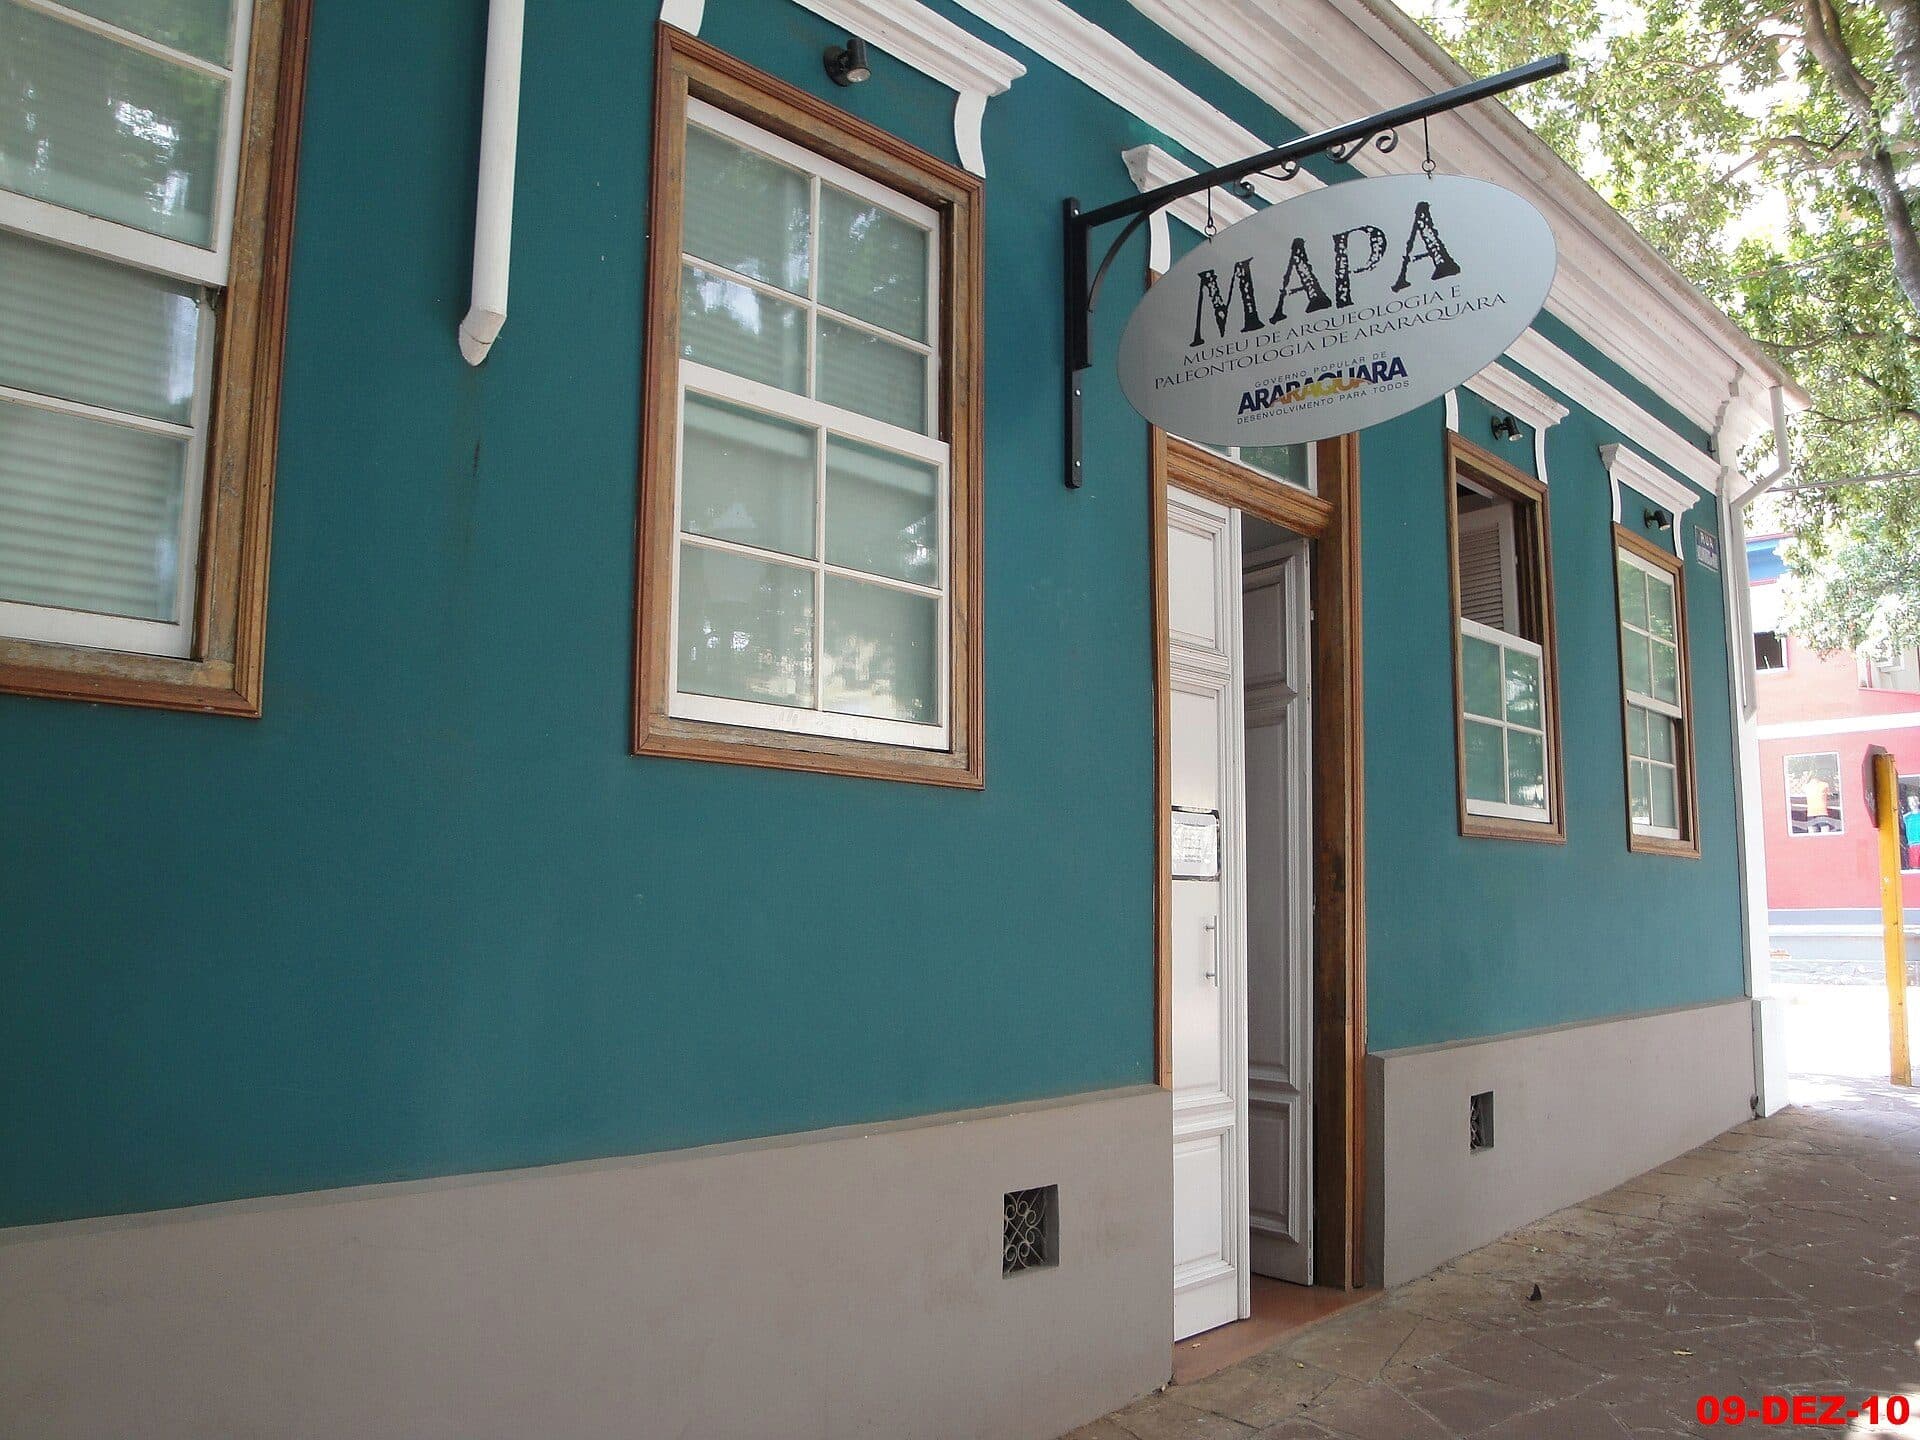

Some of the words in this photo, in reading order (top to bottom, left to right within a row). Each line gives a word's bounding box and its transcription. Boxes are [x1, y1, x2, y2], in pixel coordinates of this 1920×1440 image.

[1189, 201, 1461, 347] MAPA
[1154, 340, 1316, 389] PALEONTOLOGIA
[1322, 331, 1350, 349] DE
[1354, 293, 1507, 341] ARARAQUARA
[1183, 339, 1249, 366] MUSEU
[1256, 332, 1281, 348] DE
[1286, 291, 1444, 340] ARQUEOLOGIA
[1451, 284, 1462, 298] E
[1237, 356, 1408, 415] ARARAQUARA
[1237, 397, 1334, 425] DESENVOLVIMENTO
[1339, 390, 1367, 402] PARA
[1373, 380, 1410, 395] TODOS
[1254, 370, 1307, 388] GOVERNO
[1313, 356, 1366, 374] POPULAR
[1372, 351, 1387, 361] DE
